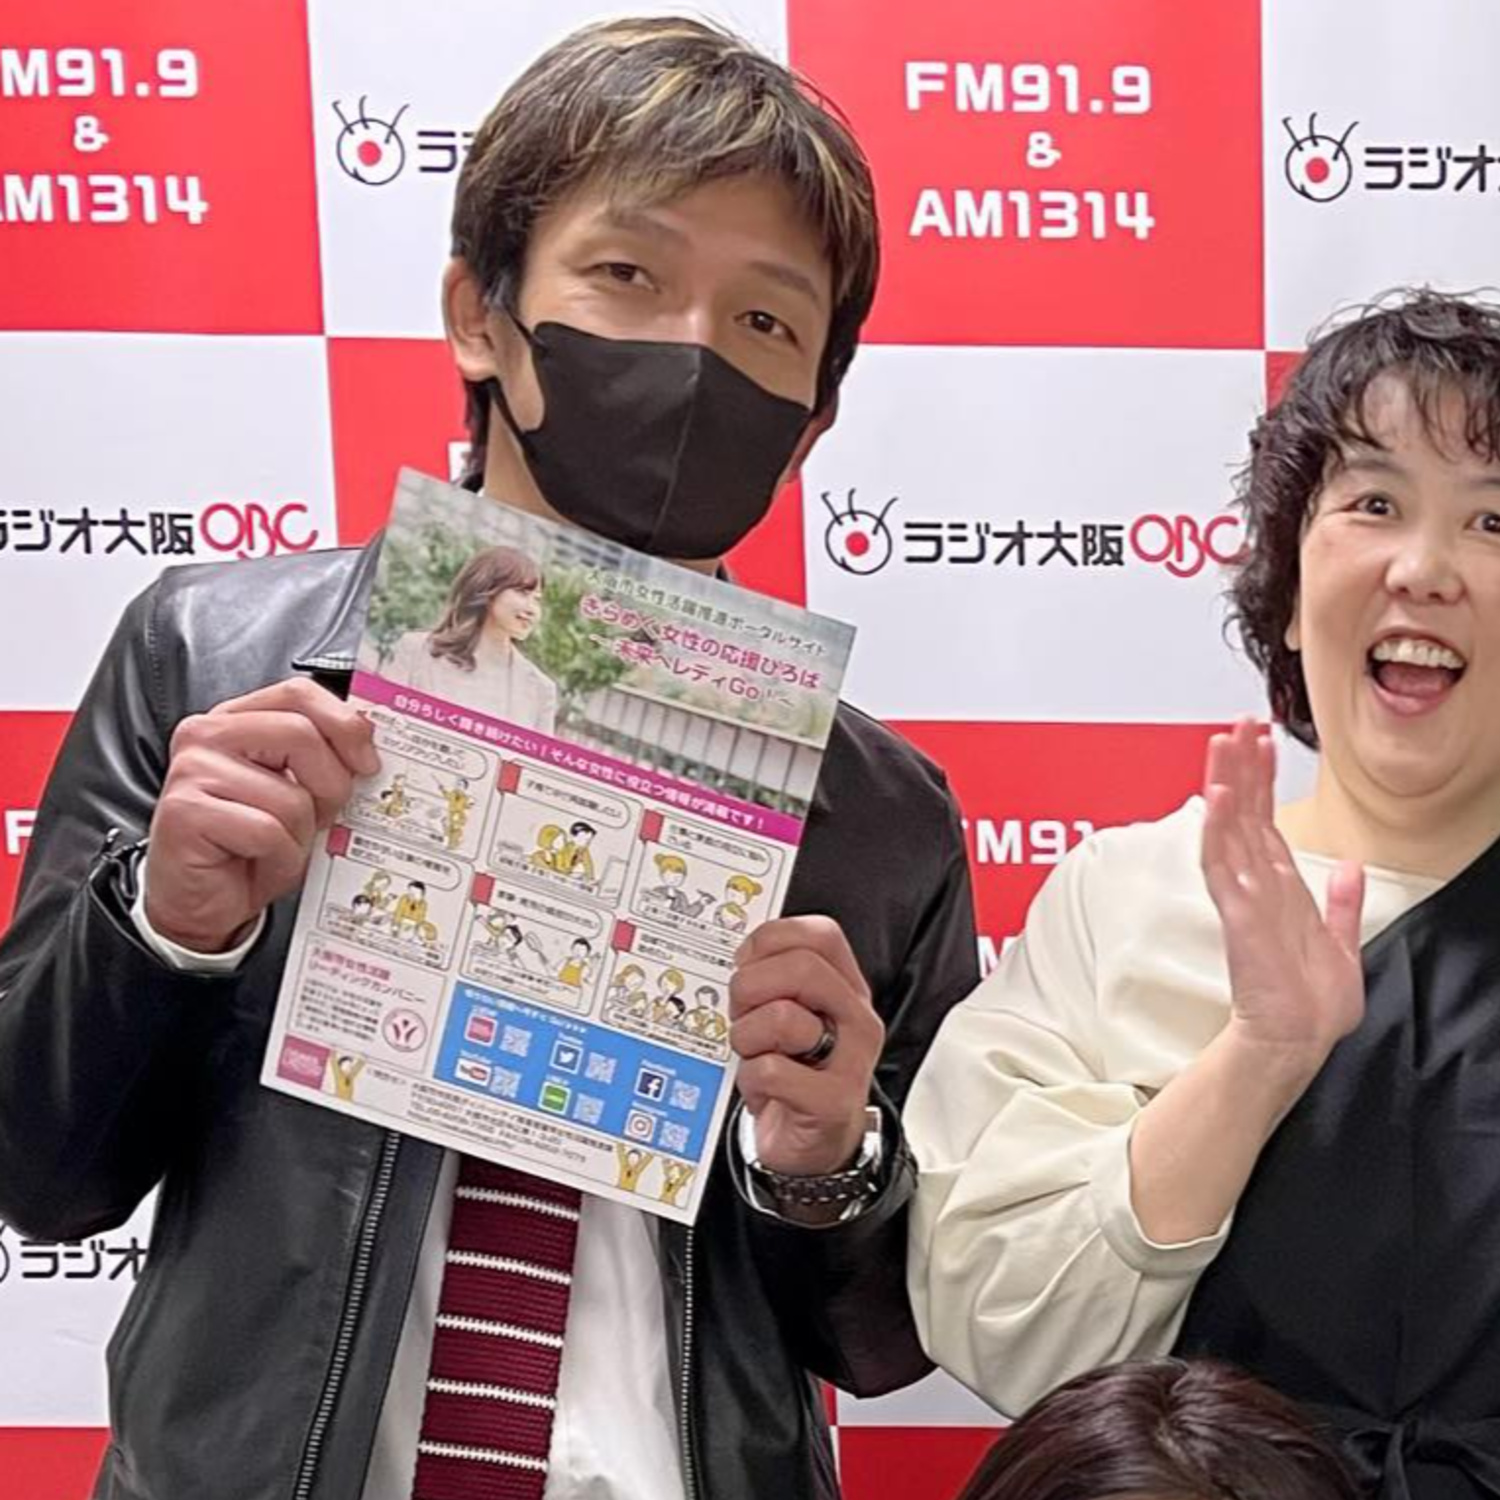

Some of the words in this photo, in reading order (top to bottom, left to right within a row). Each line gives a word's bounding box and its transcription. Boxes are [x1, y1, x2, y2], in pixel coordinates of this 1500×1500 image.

[905, 62, 1152, 114] FM91.9
[73, 115, 110, 152] &
[1026, 132, 1061, 168] &
[0, 174, 209, 224] M1314
[909, 190, 1155, 240] AM1314
[903, 523, 1125, 567] ラジオ大阪
